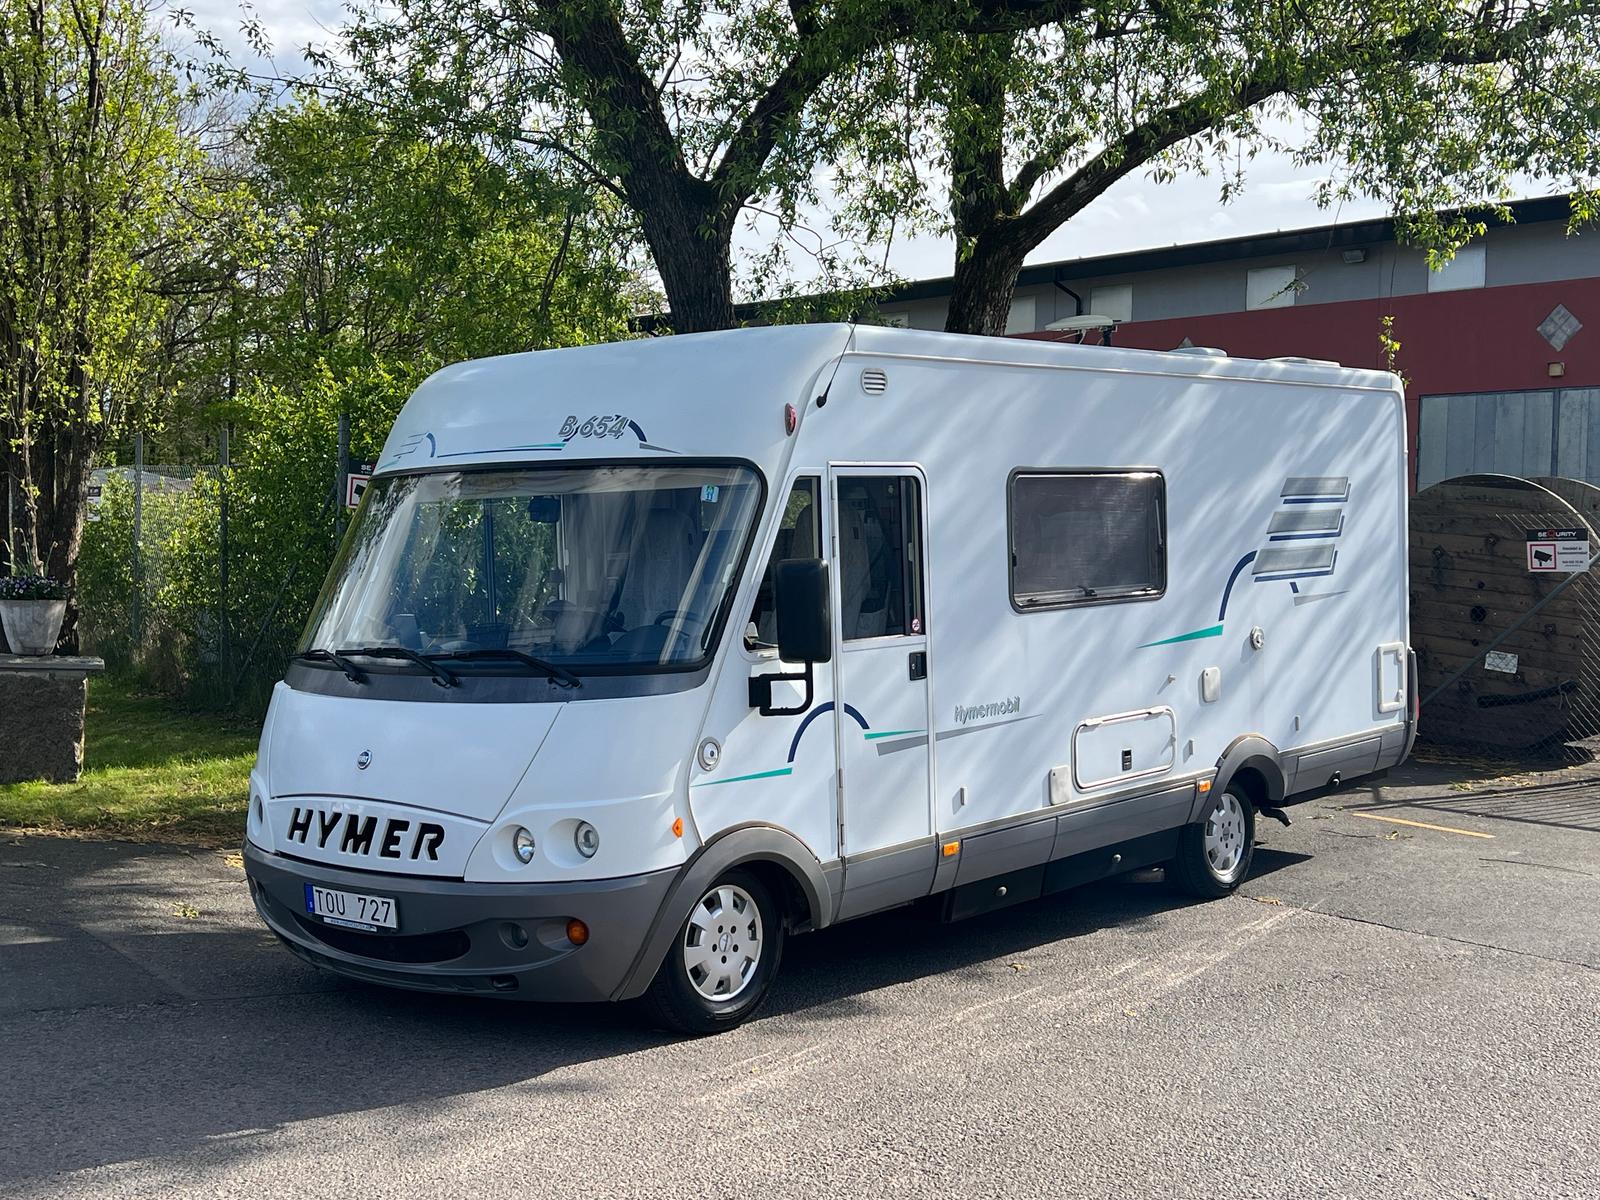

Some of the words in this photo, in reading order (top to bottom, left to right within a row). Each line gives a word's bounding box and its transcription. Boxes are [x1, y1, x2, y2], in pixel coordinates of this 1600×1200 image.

[559, 415, 577, 438] B
[579, 414, 629, 440] 654
[954, 695, 1021, 725] Hymermobil
[286, 807, 445, 861] HYMER
[315, 889, 346, 915] TOU
[357, 897, 391, 923] 727
